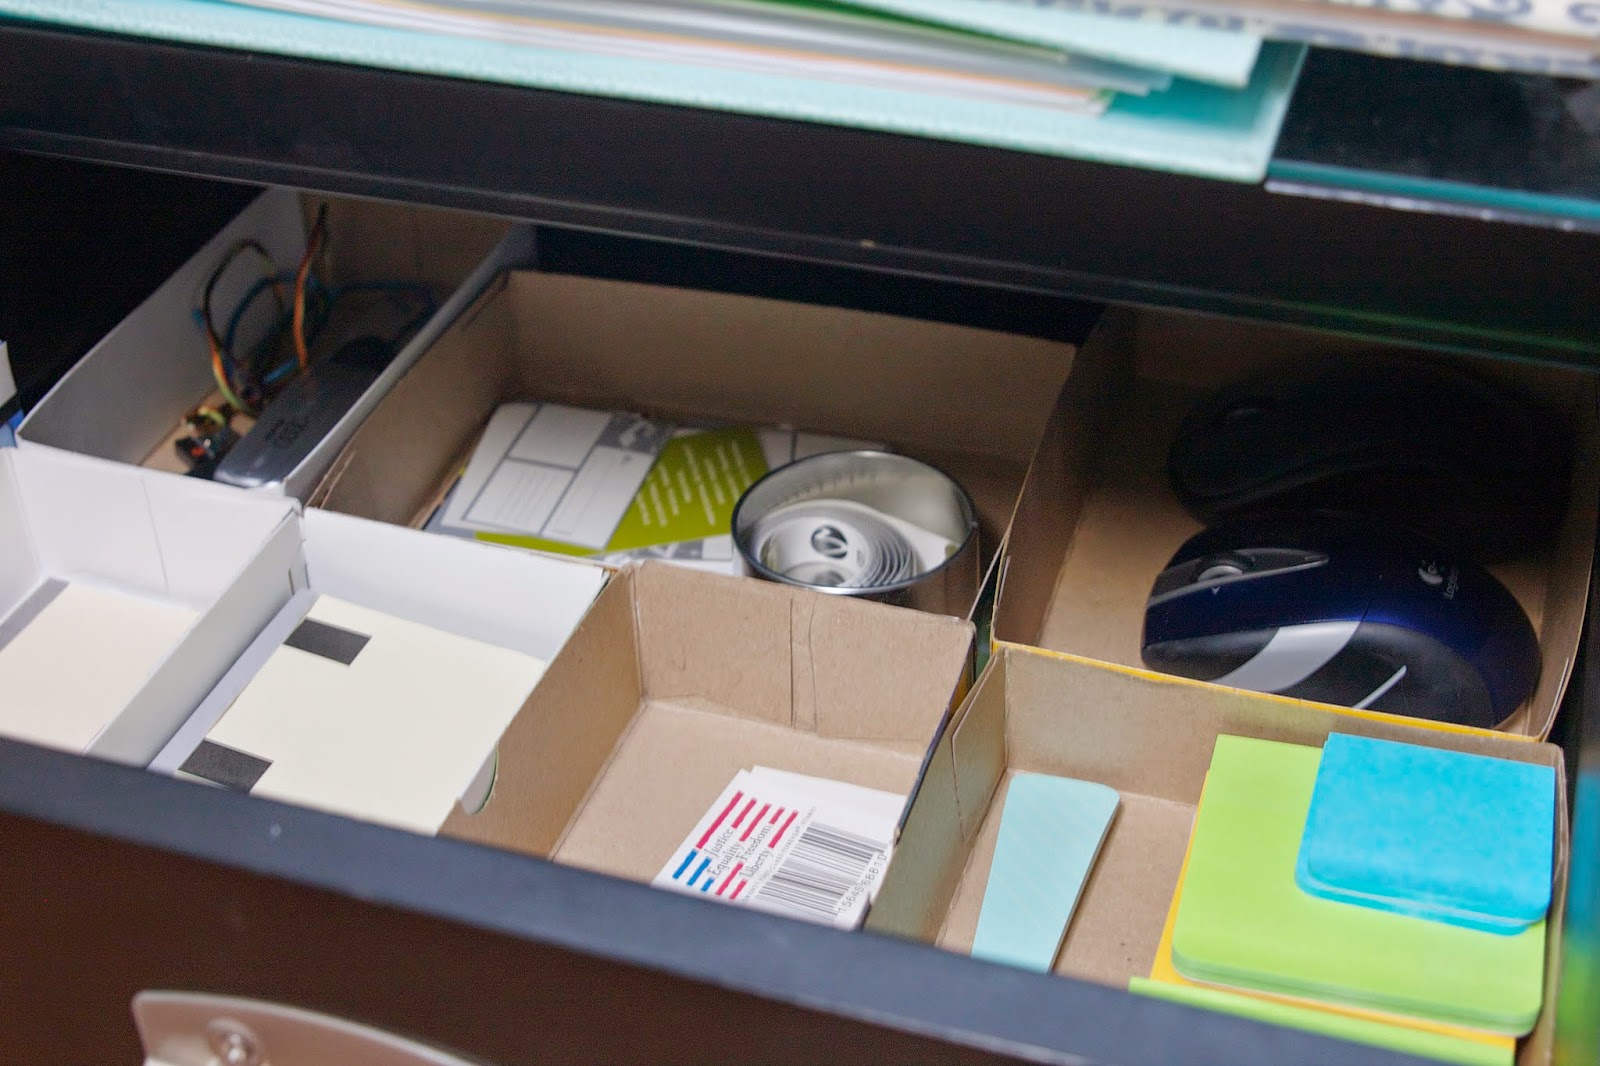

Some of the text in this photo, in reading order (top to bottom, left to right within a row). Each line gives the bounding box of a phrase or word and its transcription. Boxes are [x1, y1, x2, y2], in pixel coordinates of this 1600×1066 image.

[704, 828, 734, 858] Justice
[735, 825, 772, 861] Freedom
[707, 842, 745, 877] Equality
[739, 848, 774, 878] Liberty
